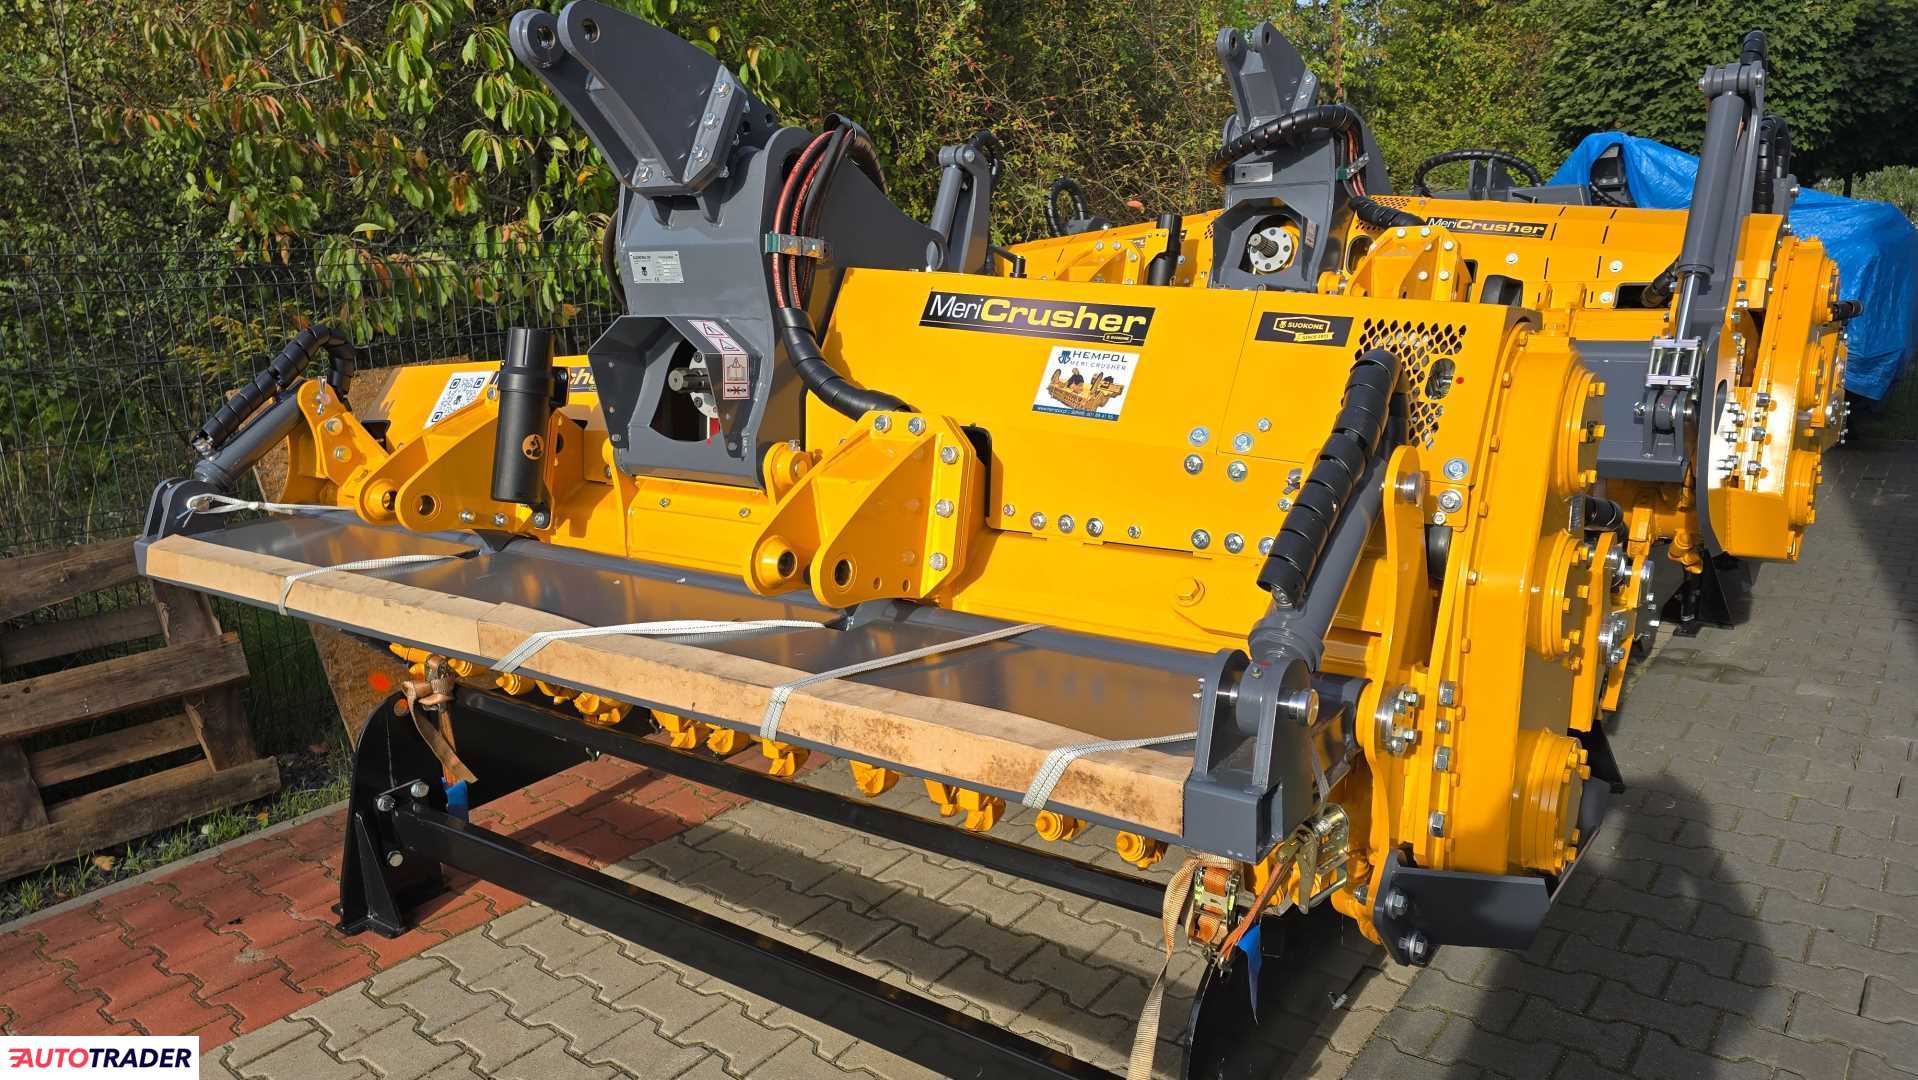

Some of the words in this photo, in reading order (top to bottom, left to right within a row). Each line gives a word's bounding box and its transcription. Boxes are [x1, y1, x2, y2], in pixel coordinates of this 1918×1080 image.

[1428, 217, 1545, 234] MeriCrusher
[929, 294, 1147, 333] MeriCrusher
[1287, 321, 1324, 330] SUOKONE
[1072, 350, 1128, 363] HEMPOL
